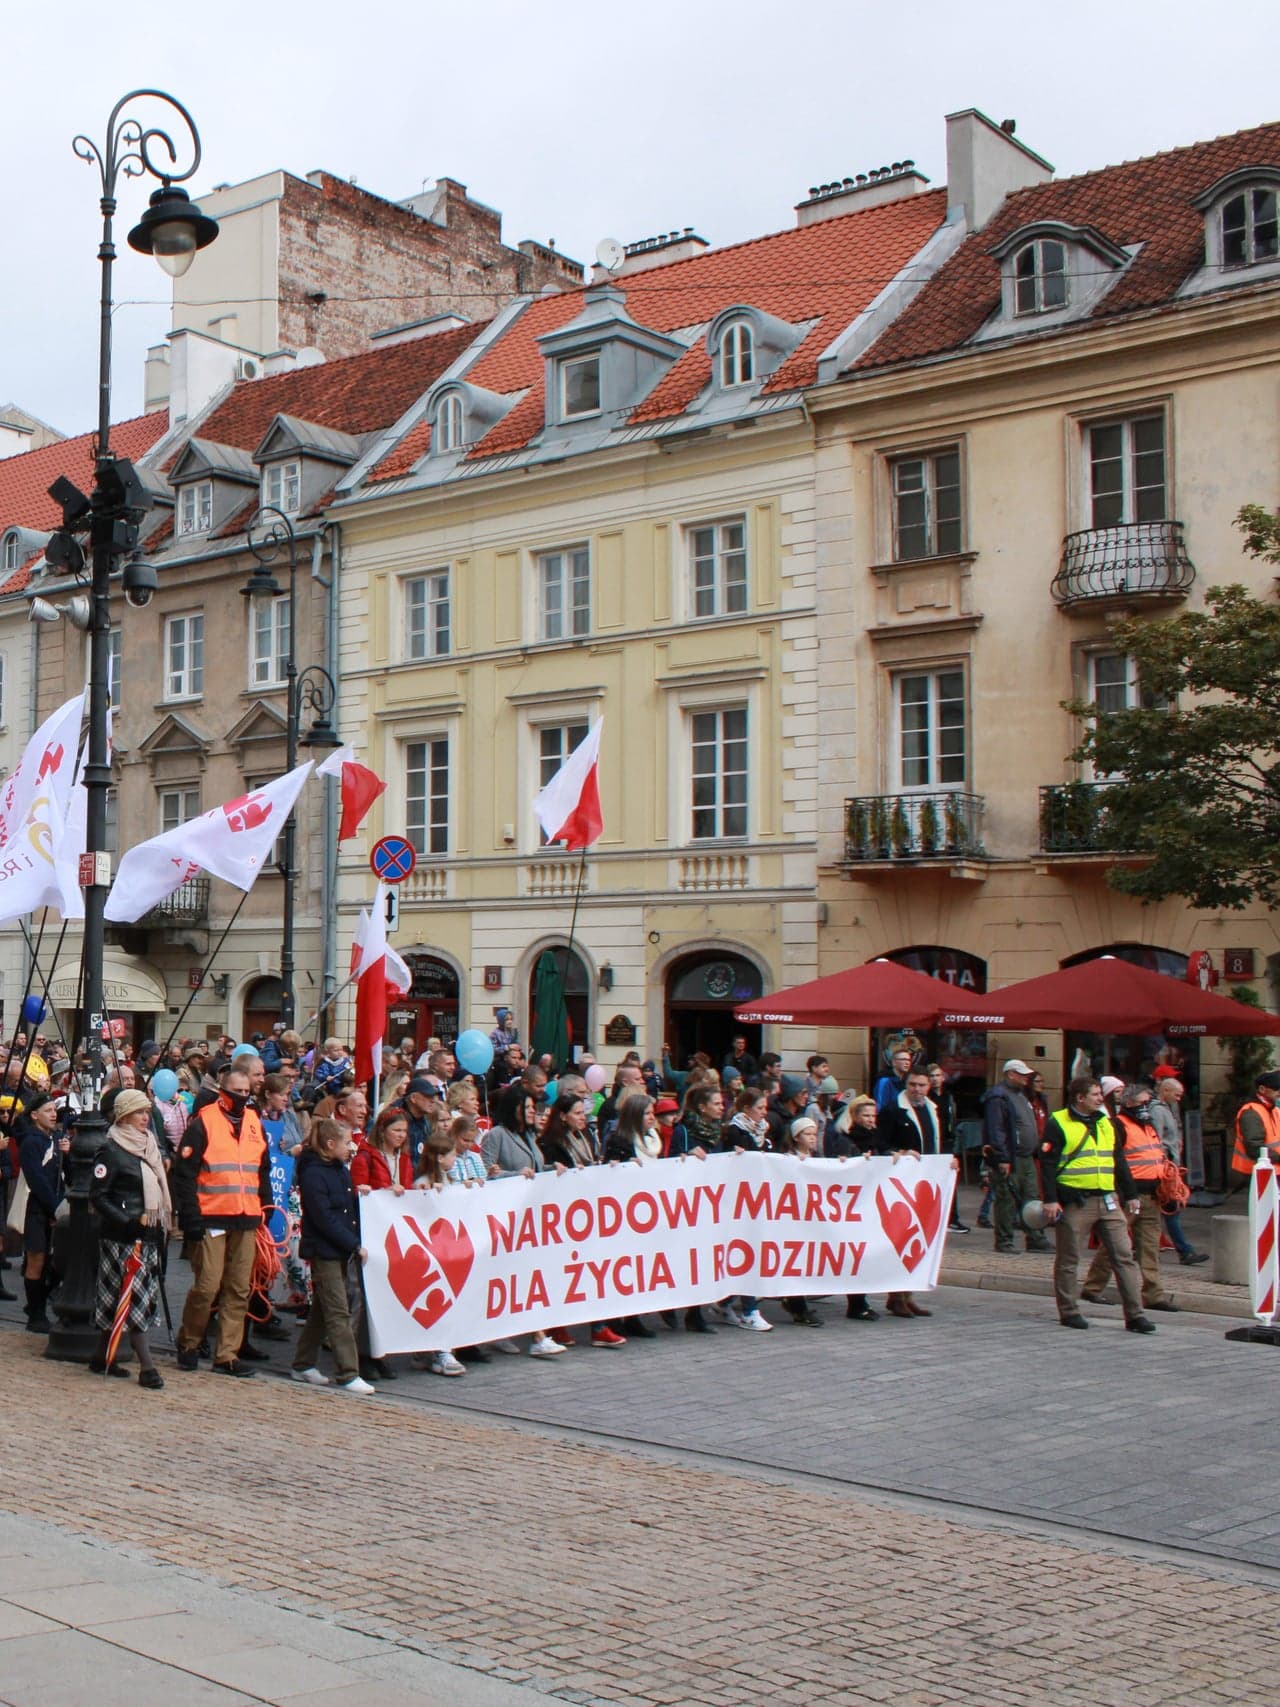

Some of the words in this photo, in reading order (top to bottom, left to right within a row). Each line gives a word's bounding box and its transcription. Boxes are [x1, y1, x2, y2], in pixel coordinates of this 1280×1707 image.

[1233, 958, 1243, 973] 8
[488, 974, 498, 984] 10
[764, 1014, 793, 1022] COFFEE
[945, 1015, 970, 1023] COSTA
[973, 1015, 1005, 1023] COFFEE
[486, 1183, 726, 1257] NARODOWY
[733, 1181, 863, 1223] MARSZ
[486, 1269, 550, 1320] DLA
[564, 1250, 676, 1305] ŻYCIA
[689, 1248, 699, 1286] I
[713, 1238, 867, 1283] RODZINY
